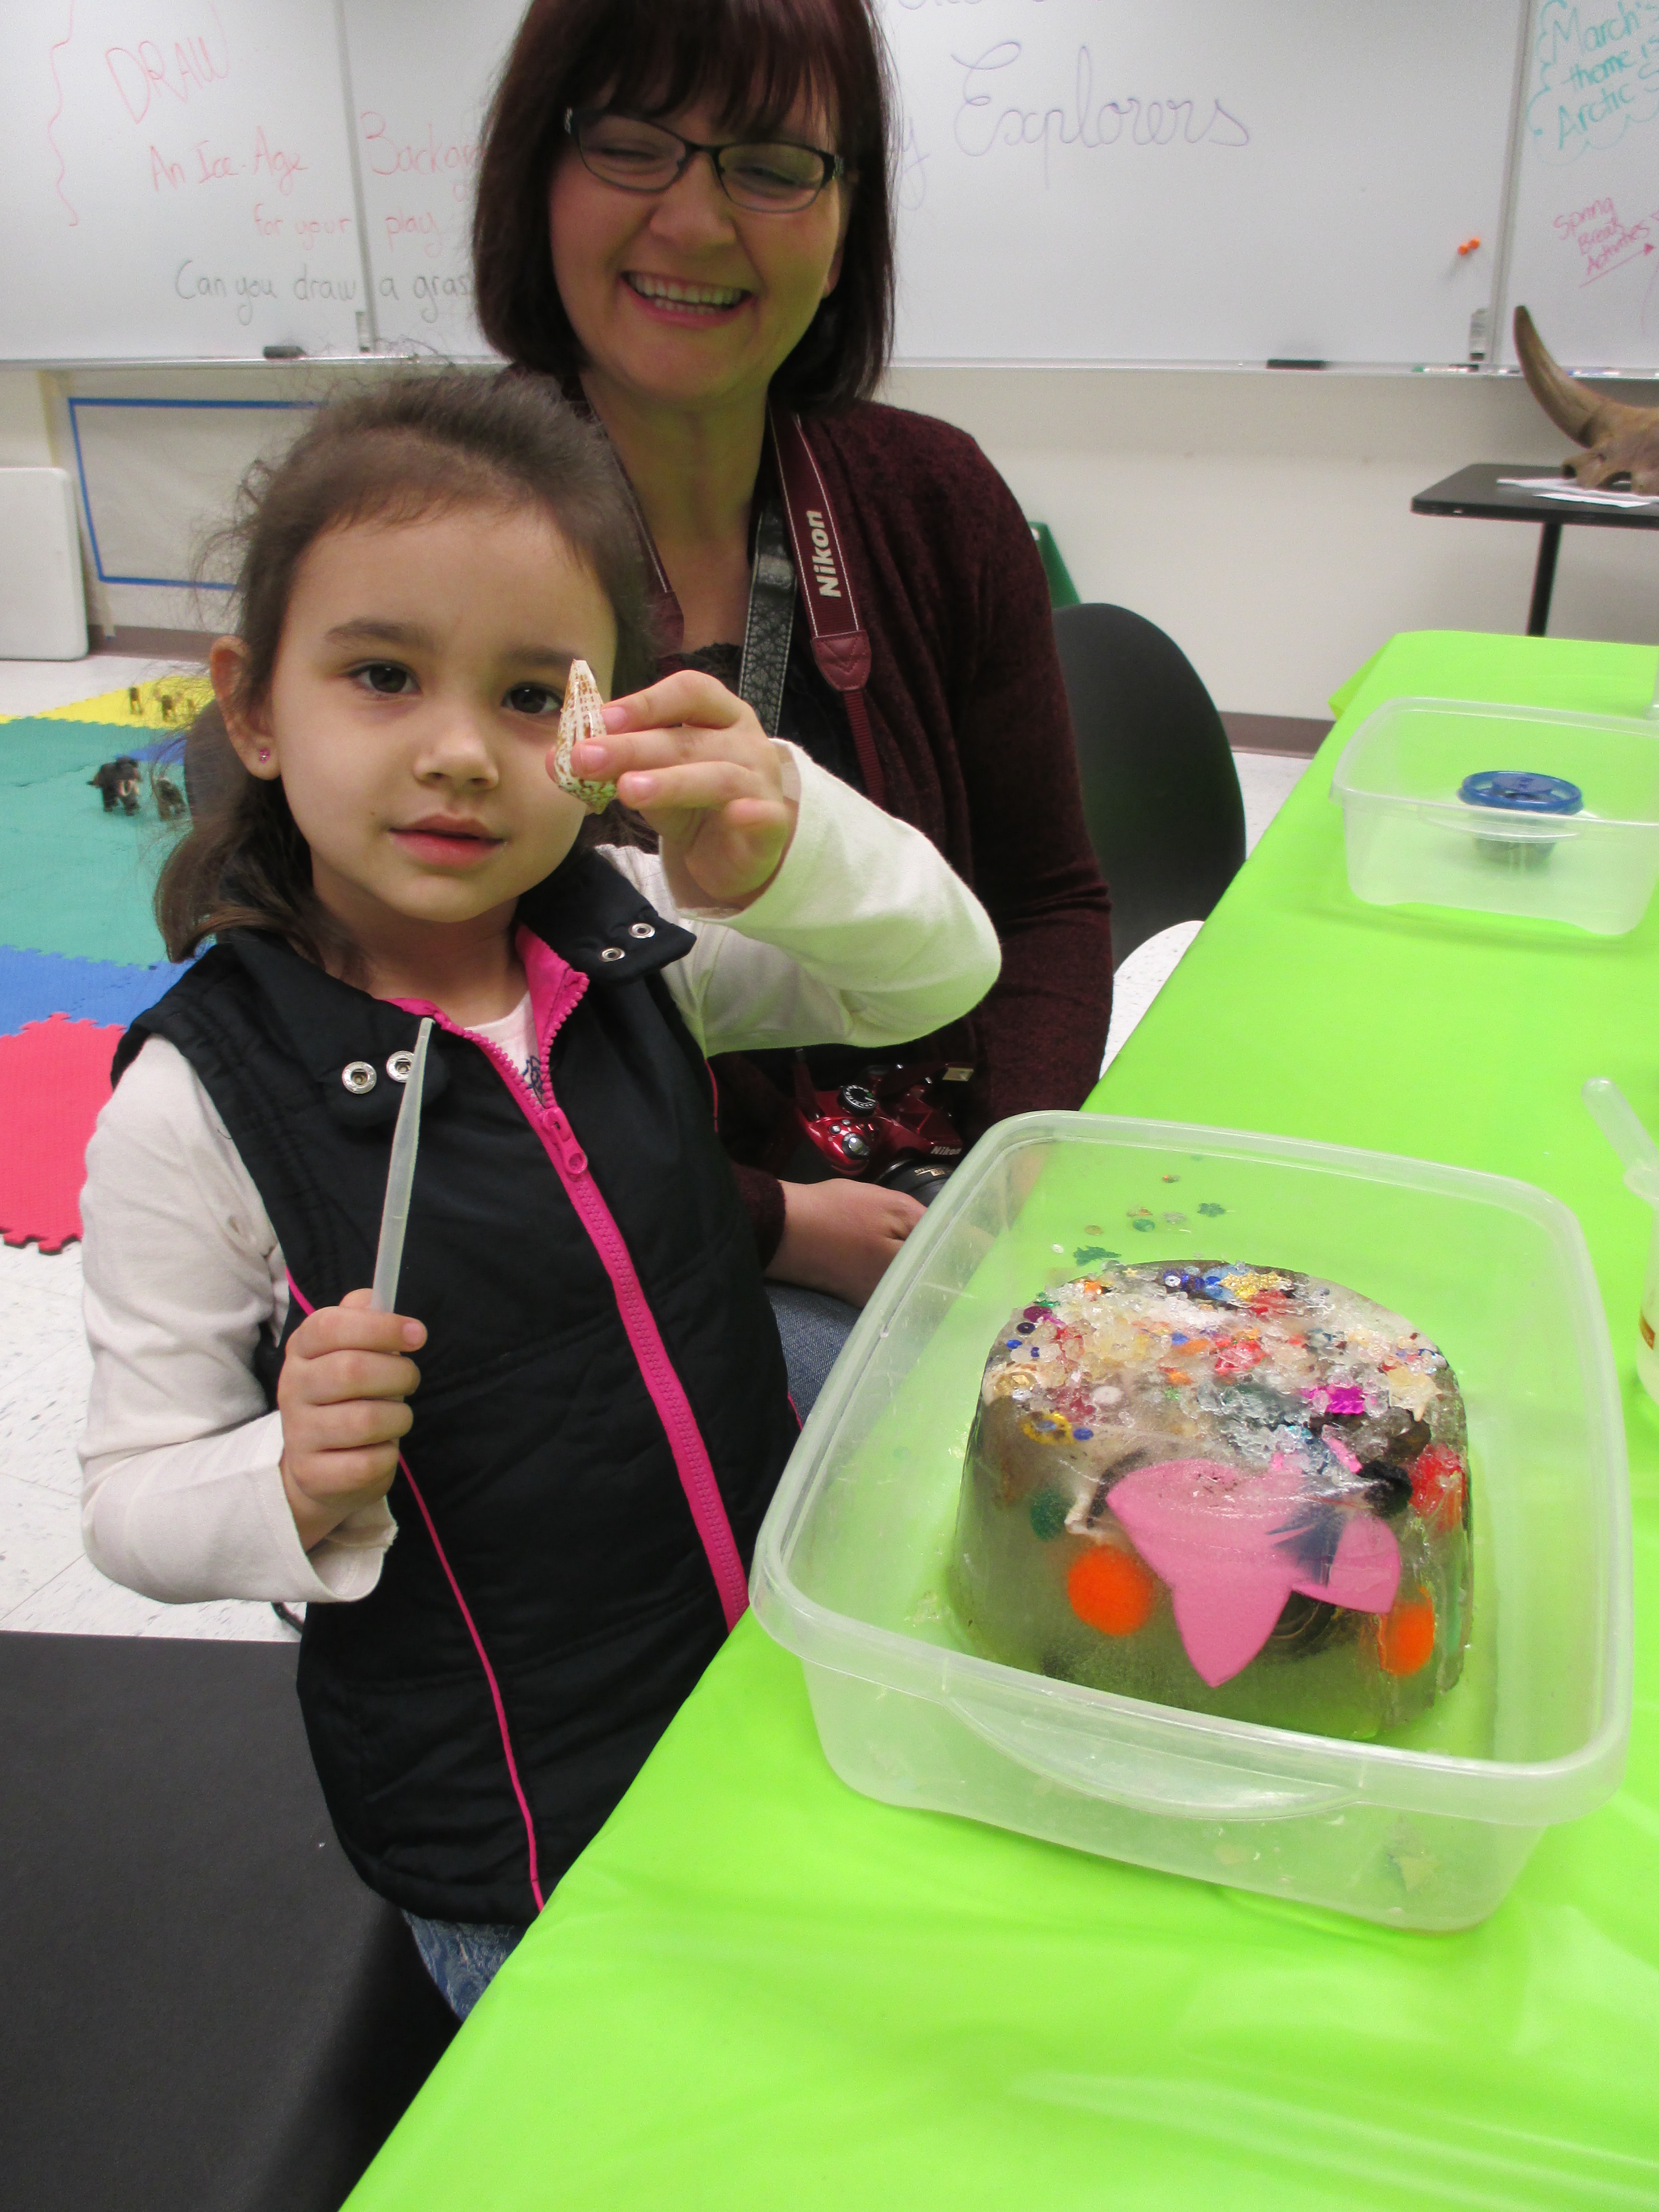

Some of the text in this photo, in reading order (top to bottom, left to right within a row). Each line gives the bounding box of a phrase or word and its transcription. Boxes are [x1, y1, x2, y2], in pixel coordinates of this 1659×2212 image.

[105, 0, 229, 125] DRAW
[950, 40, 1249, 189] Explorers
[1558, 84, 1635, 150] Arctic
[150, 145, 186, 192] An
[253, 204, 444, 258] for your play
[1552, 196, 1618, 241] Spring
[175, 259, 227, 300] Can
[235, 276, 278, 326] you
[293, 263, 356, 301] draw
[379, 277, 399, 301] a
[806, 510, 842, 598] Nikon
[930, 1145, 962, 1155] Nikon
